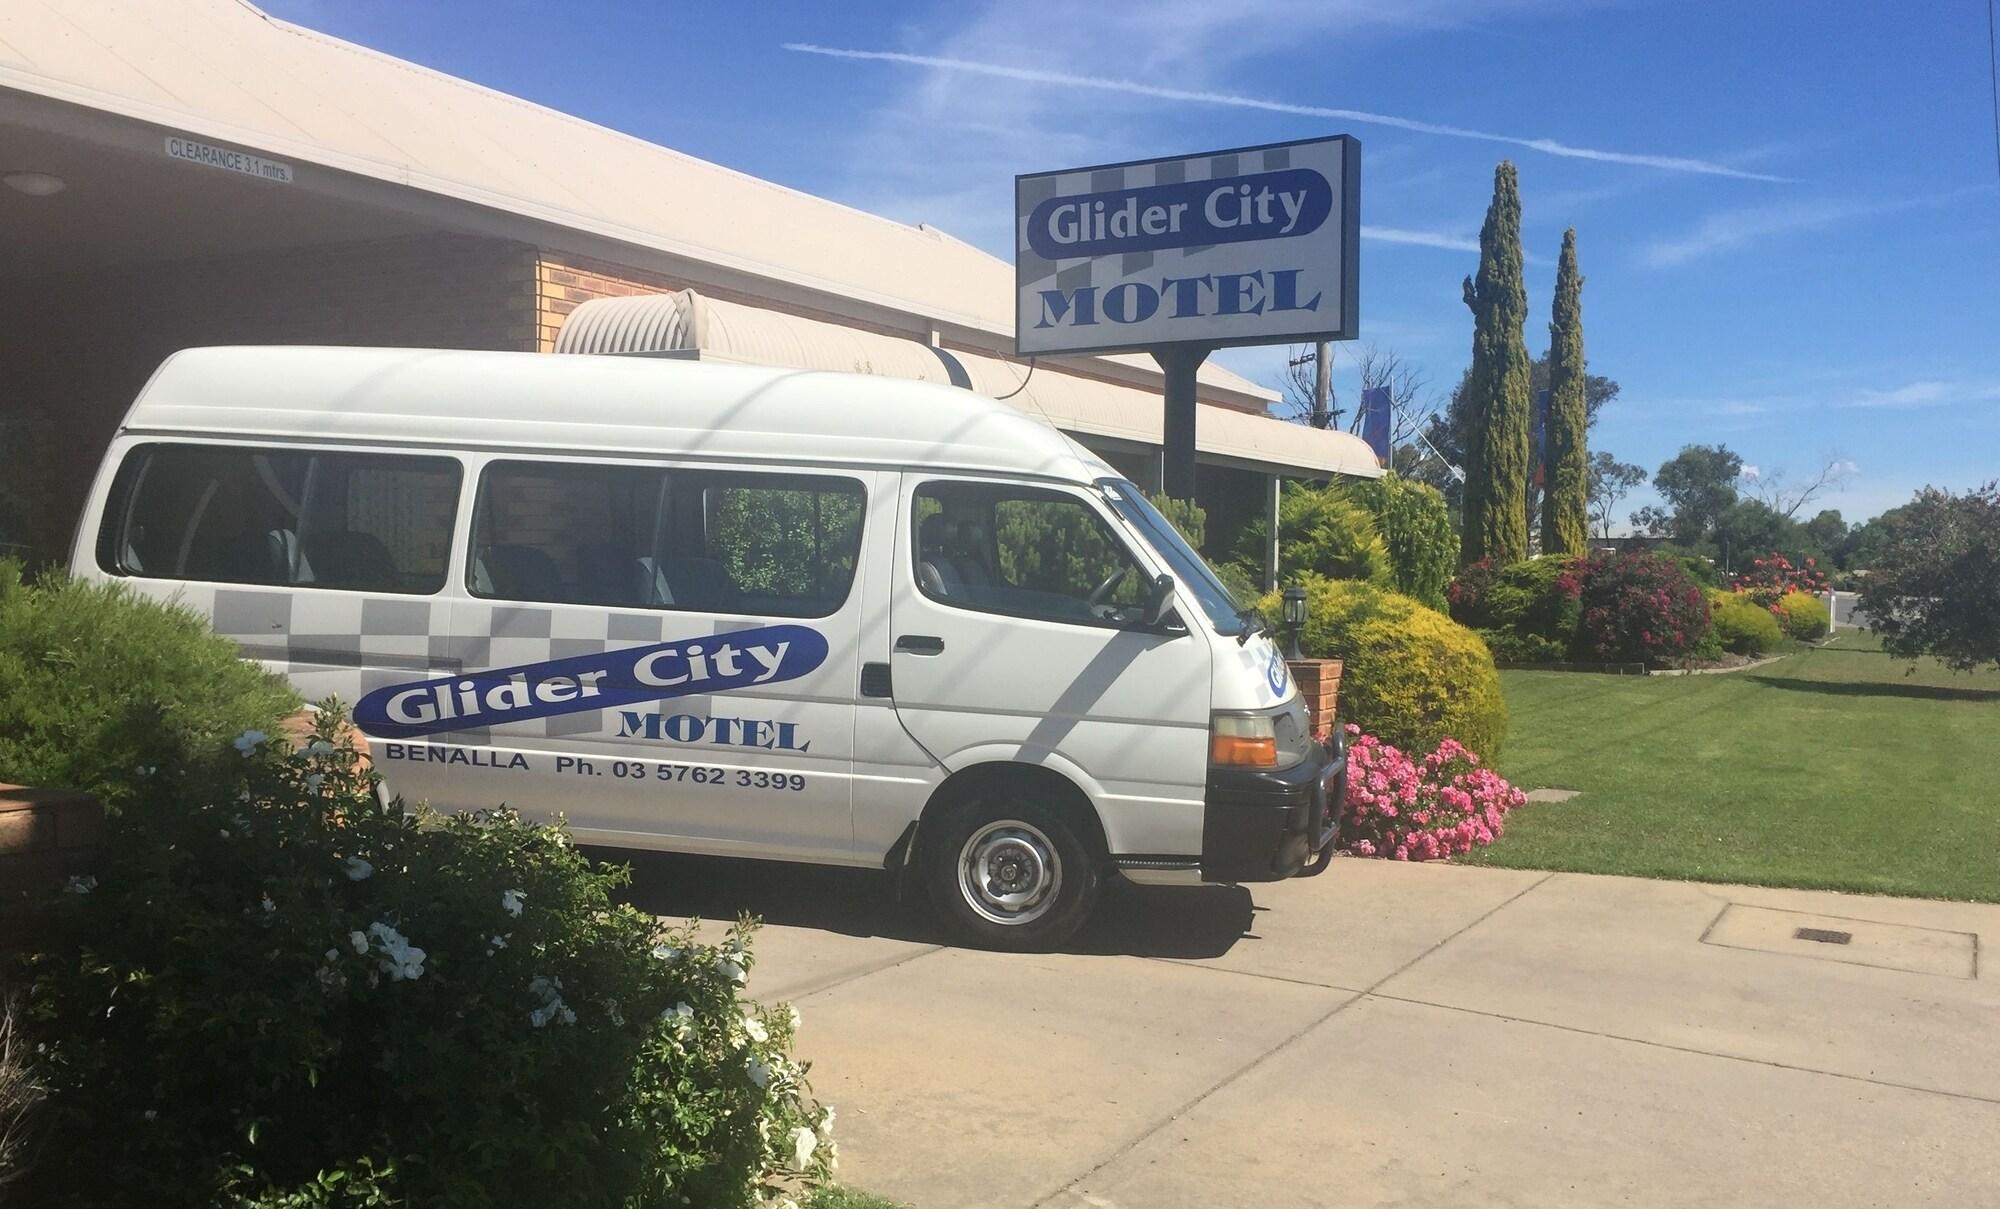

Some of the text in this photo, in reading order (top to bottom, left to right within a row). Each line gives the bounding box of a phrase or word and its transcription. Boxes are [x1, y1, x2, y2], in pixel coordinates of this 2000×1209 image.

[170, 139, 289, 181] CLEARANCE 3.1 mtrs.
[1048, 184, 1307, 244] Glider City
[1033, 269, 1322, 328] MOTEL
[385, 641, 790, 725] Glider City
[615, 710, 811, 753] MOTEL
[385, 743, 806, 792] BENALLA Ph. 03 5762 3399
